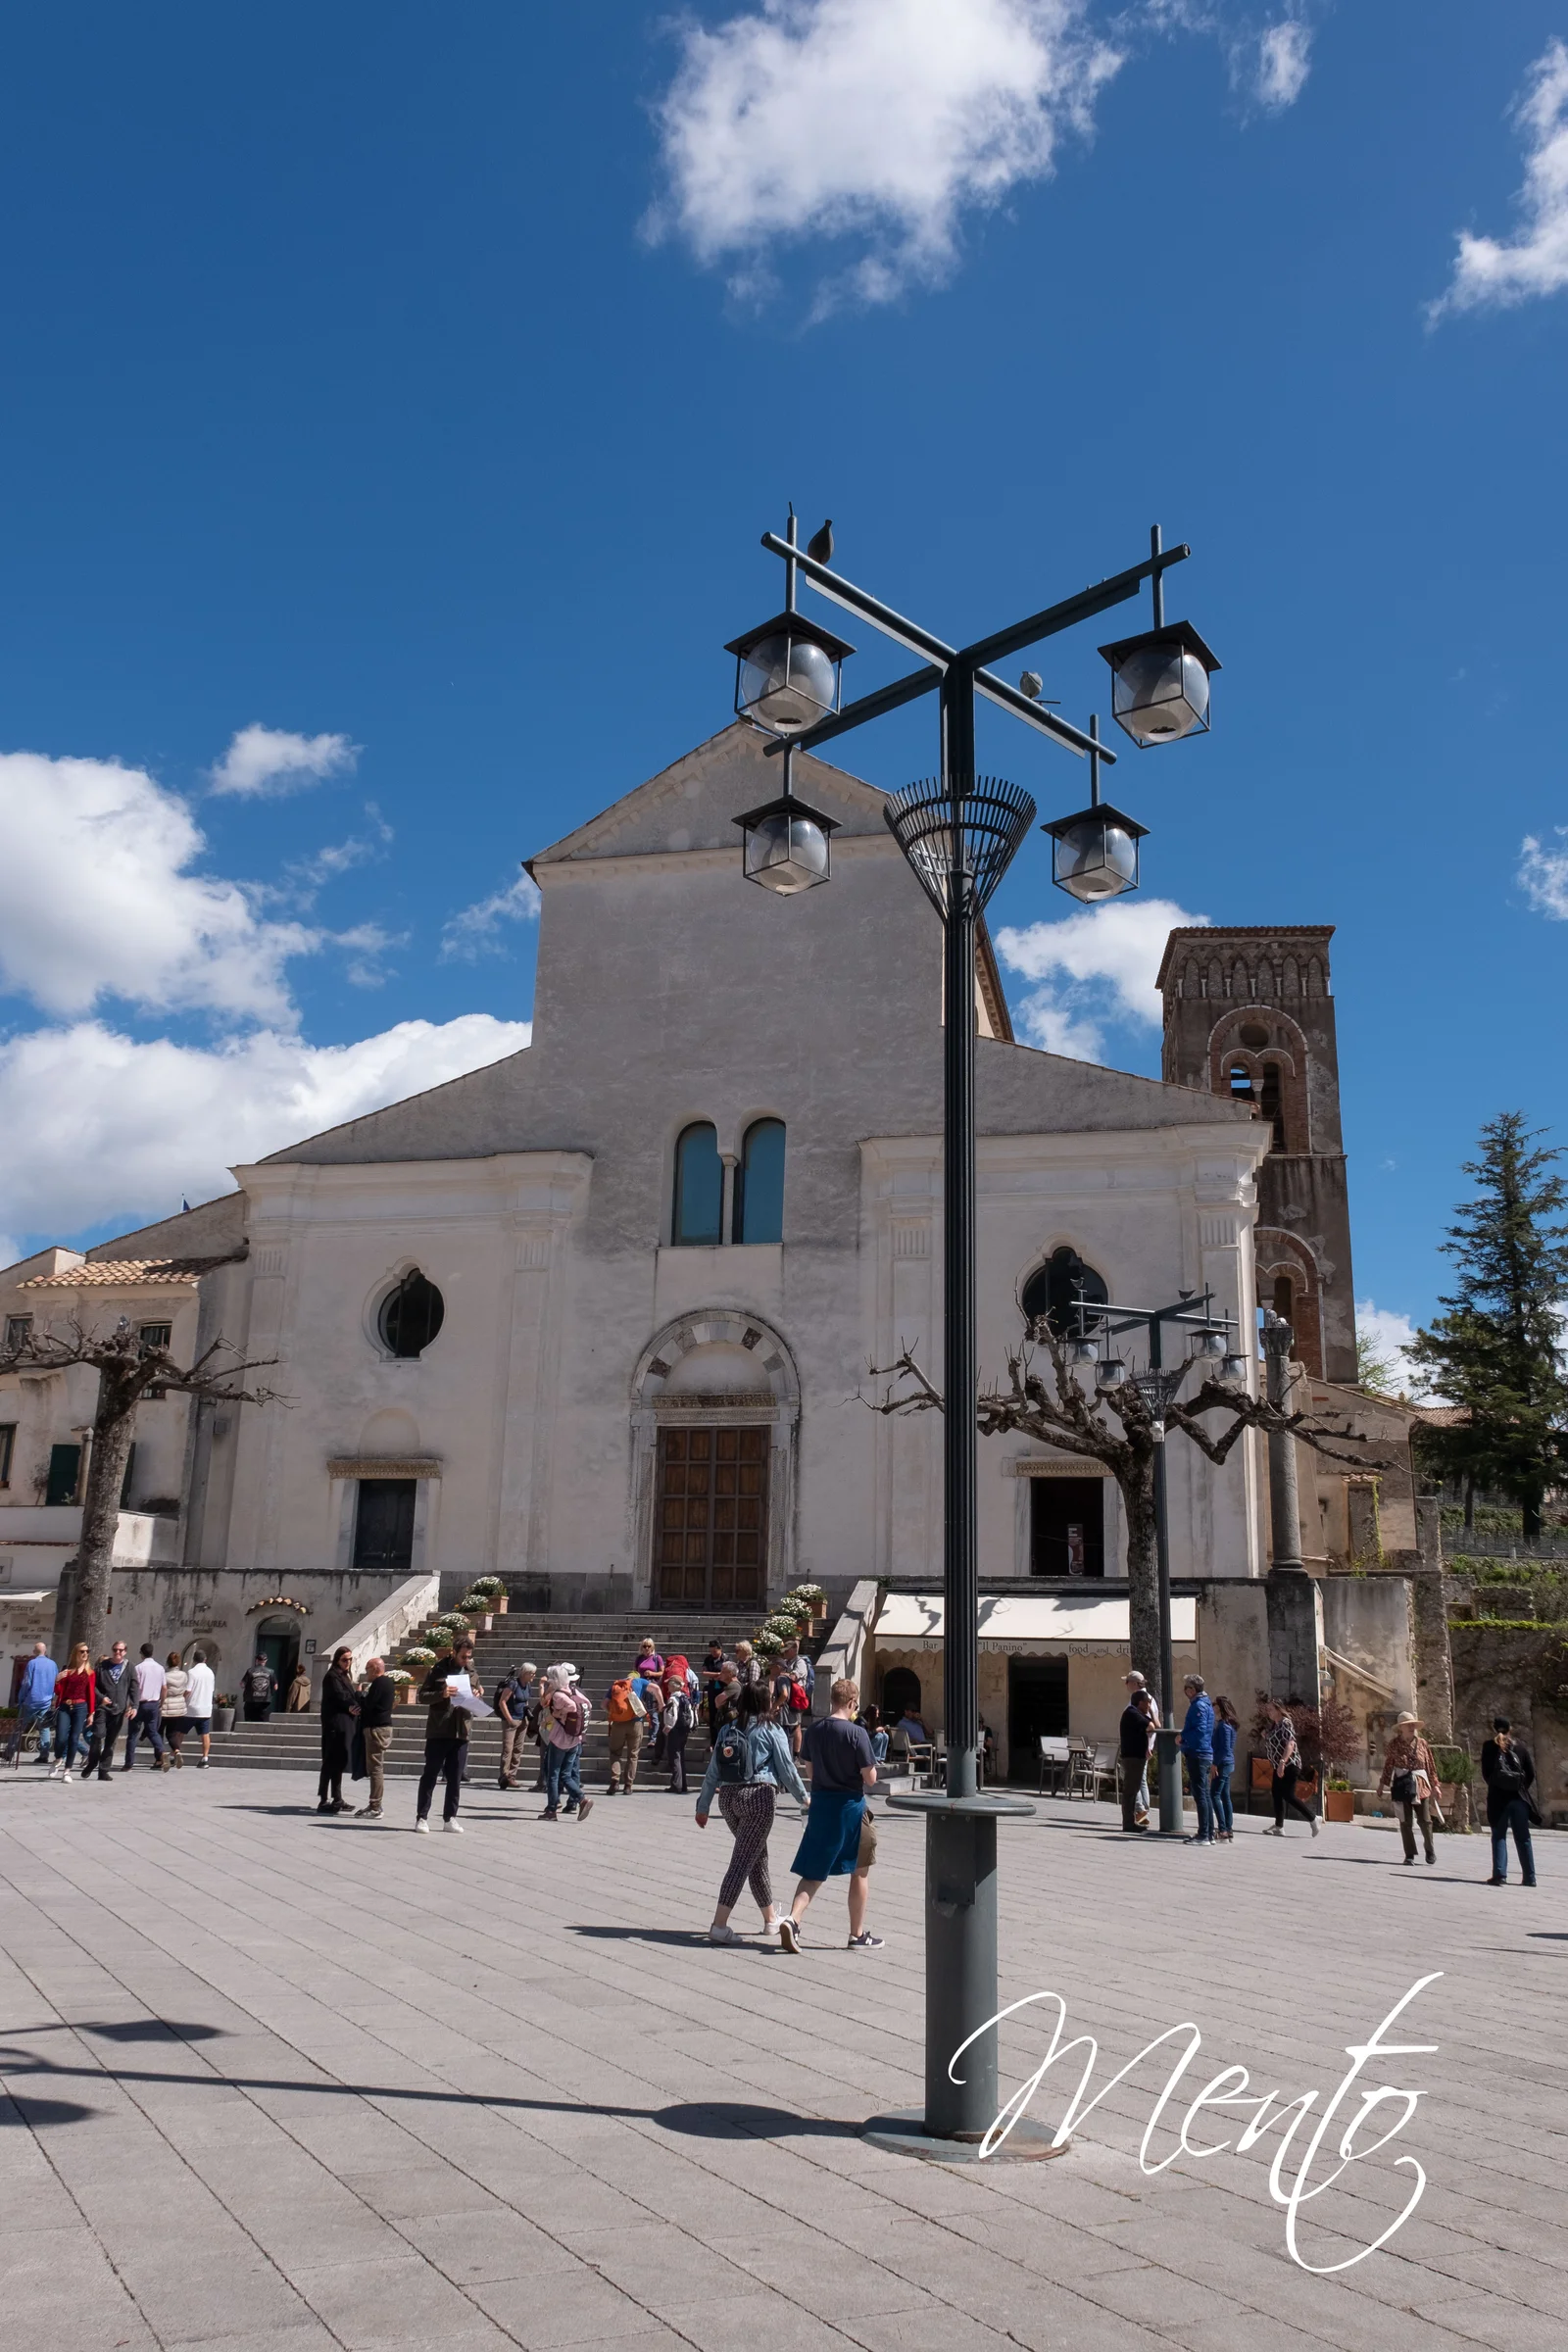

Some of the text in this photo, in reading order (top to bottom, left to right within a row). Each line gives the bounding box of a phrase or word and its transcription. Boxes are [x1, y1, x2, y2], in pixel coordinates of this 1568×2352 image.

[923, 1641, 938, 1649] Bar
[1068, 1643, 1089, 1653] food
[1116, 1644, 1131, 1654] dri
